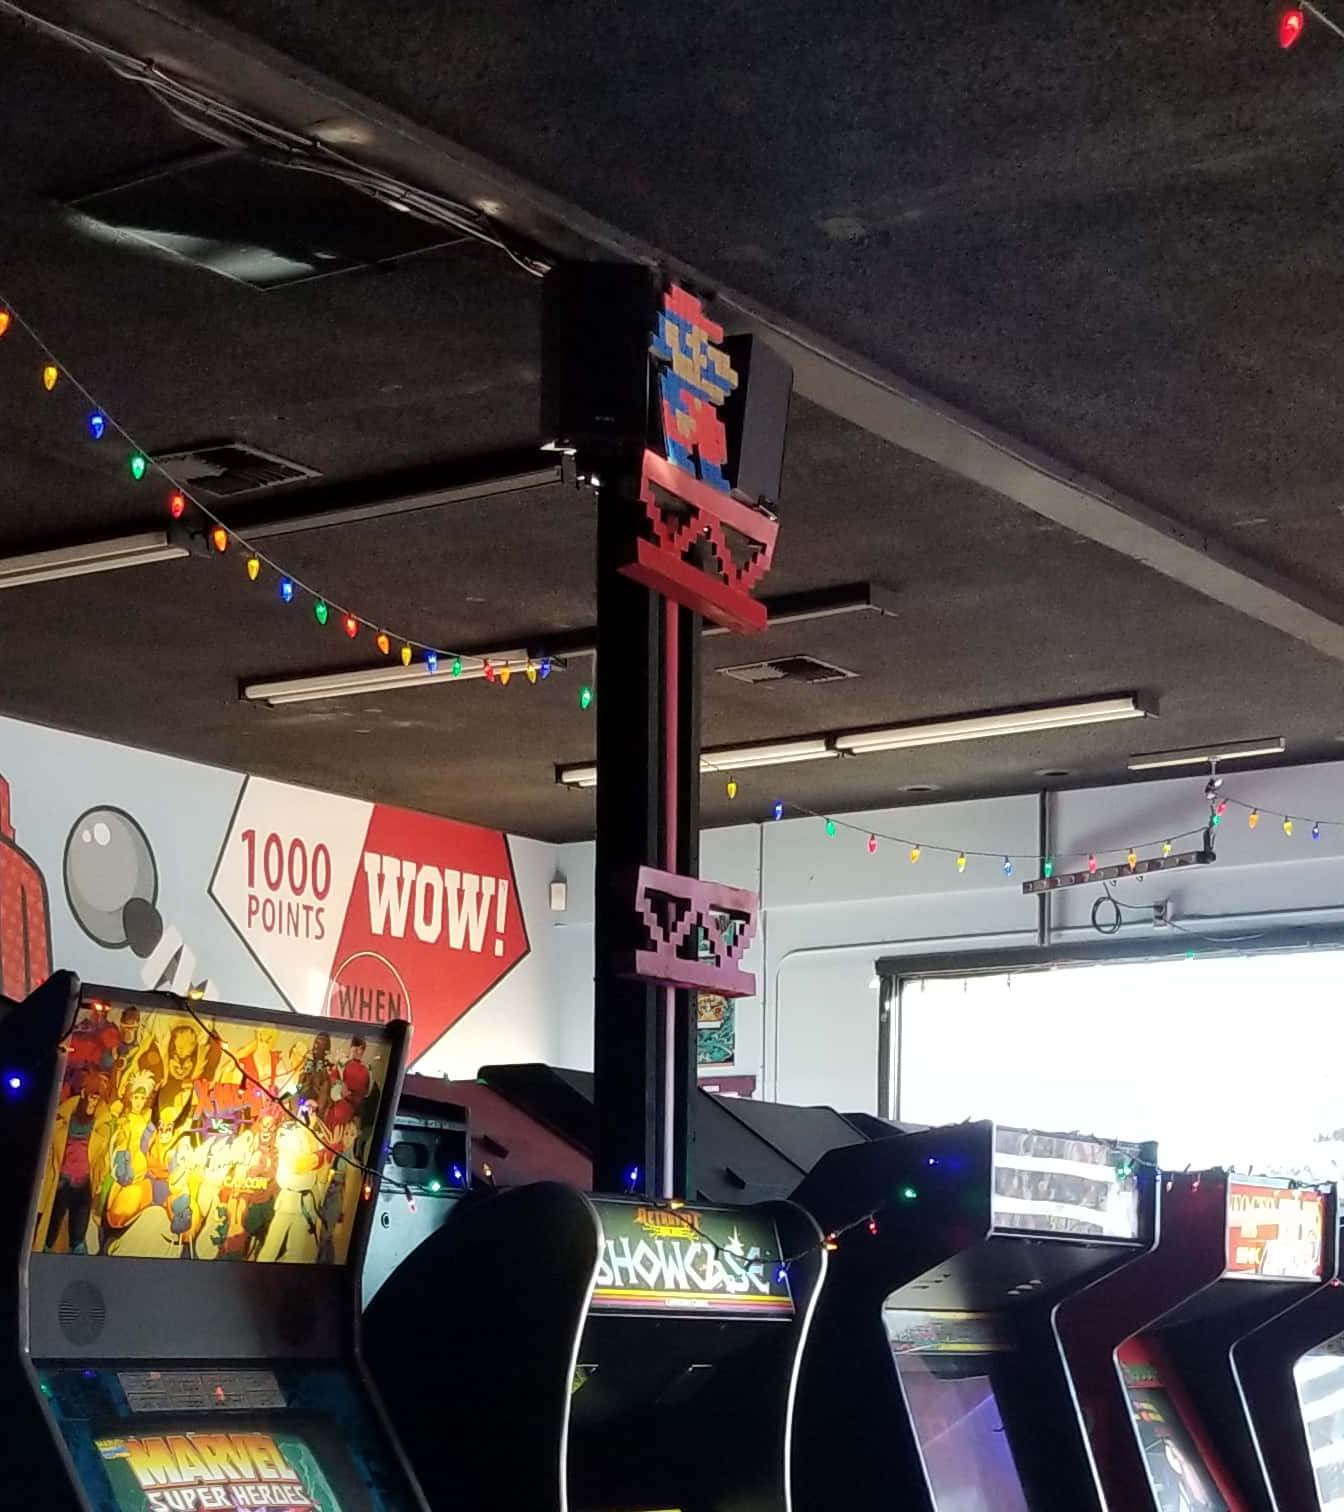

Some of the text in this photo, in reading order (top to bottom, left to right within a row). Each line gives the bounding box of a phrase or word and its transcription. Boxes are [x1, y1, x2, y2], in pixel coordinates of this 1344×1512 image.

[241, 829, 332, 901] 1000
[247, 894, 326, 940] POINTS
[363, 851, 509, 957] WOW!
[339, 985, 402, 1023] WHEN
[127, 1433, 301, 1490] MARVEL
[231, 1484, 312, 1508] HEROES
